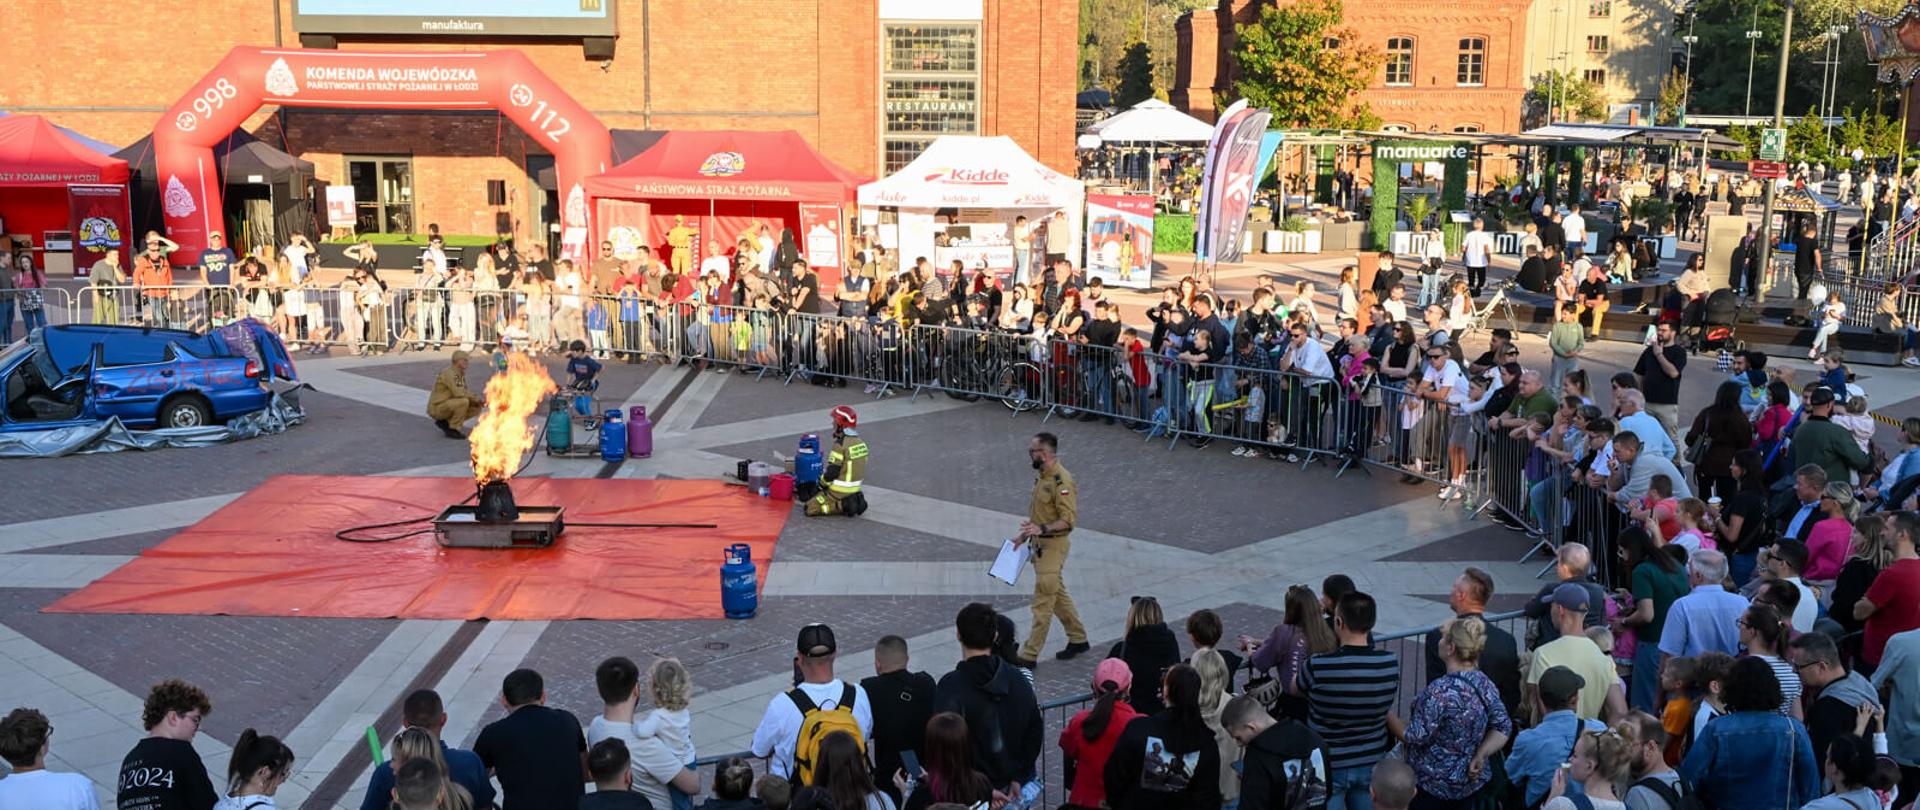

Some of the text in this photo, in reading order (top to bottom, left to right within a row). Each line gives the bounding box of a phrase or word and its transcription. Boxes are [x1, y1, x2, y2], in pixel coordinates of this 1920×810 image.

[422, 19, 484, 30] manufaktura
[306, 66, 477, 81] KOMENDA WOJEWÓDZKA
[306, 80, 479, 91] PAŃSTWOWEJ STRAŻY POŻARNEJ W ŁODZI
[193, 78, 237, 119] 998
[887, 101, 975, 111] RESTAURANT
[530, 101, 570, 143] 112
[1376, 145, 1467, 159] manuarte
[951, 168, 1009, 182] Kidde
[635, 182, 790, 197] PAŃSTWOWA STRAŻ POŻARNA
[942, 193, 980, 204] kidde.pl
[126, 767, 174, 788] 2024
